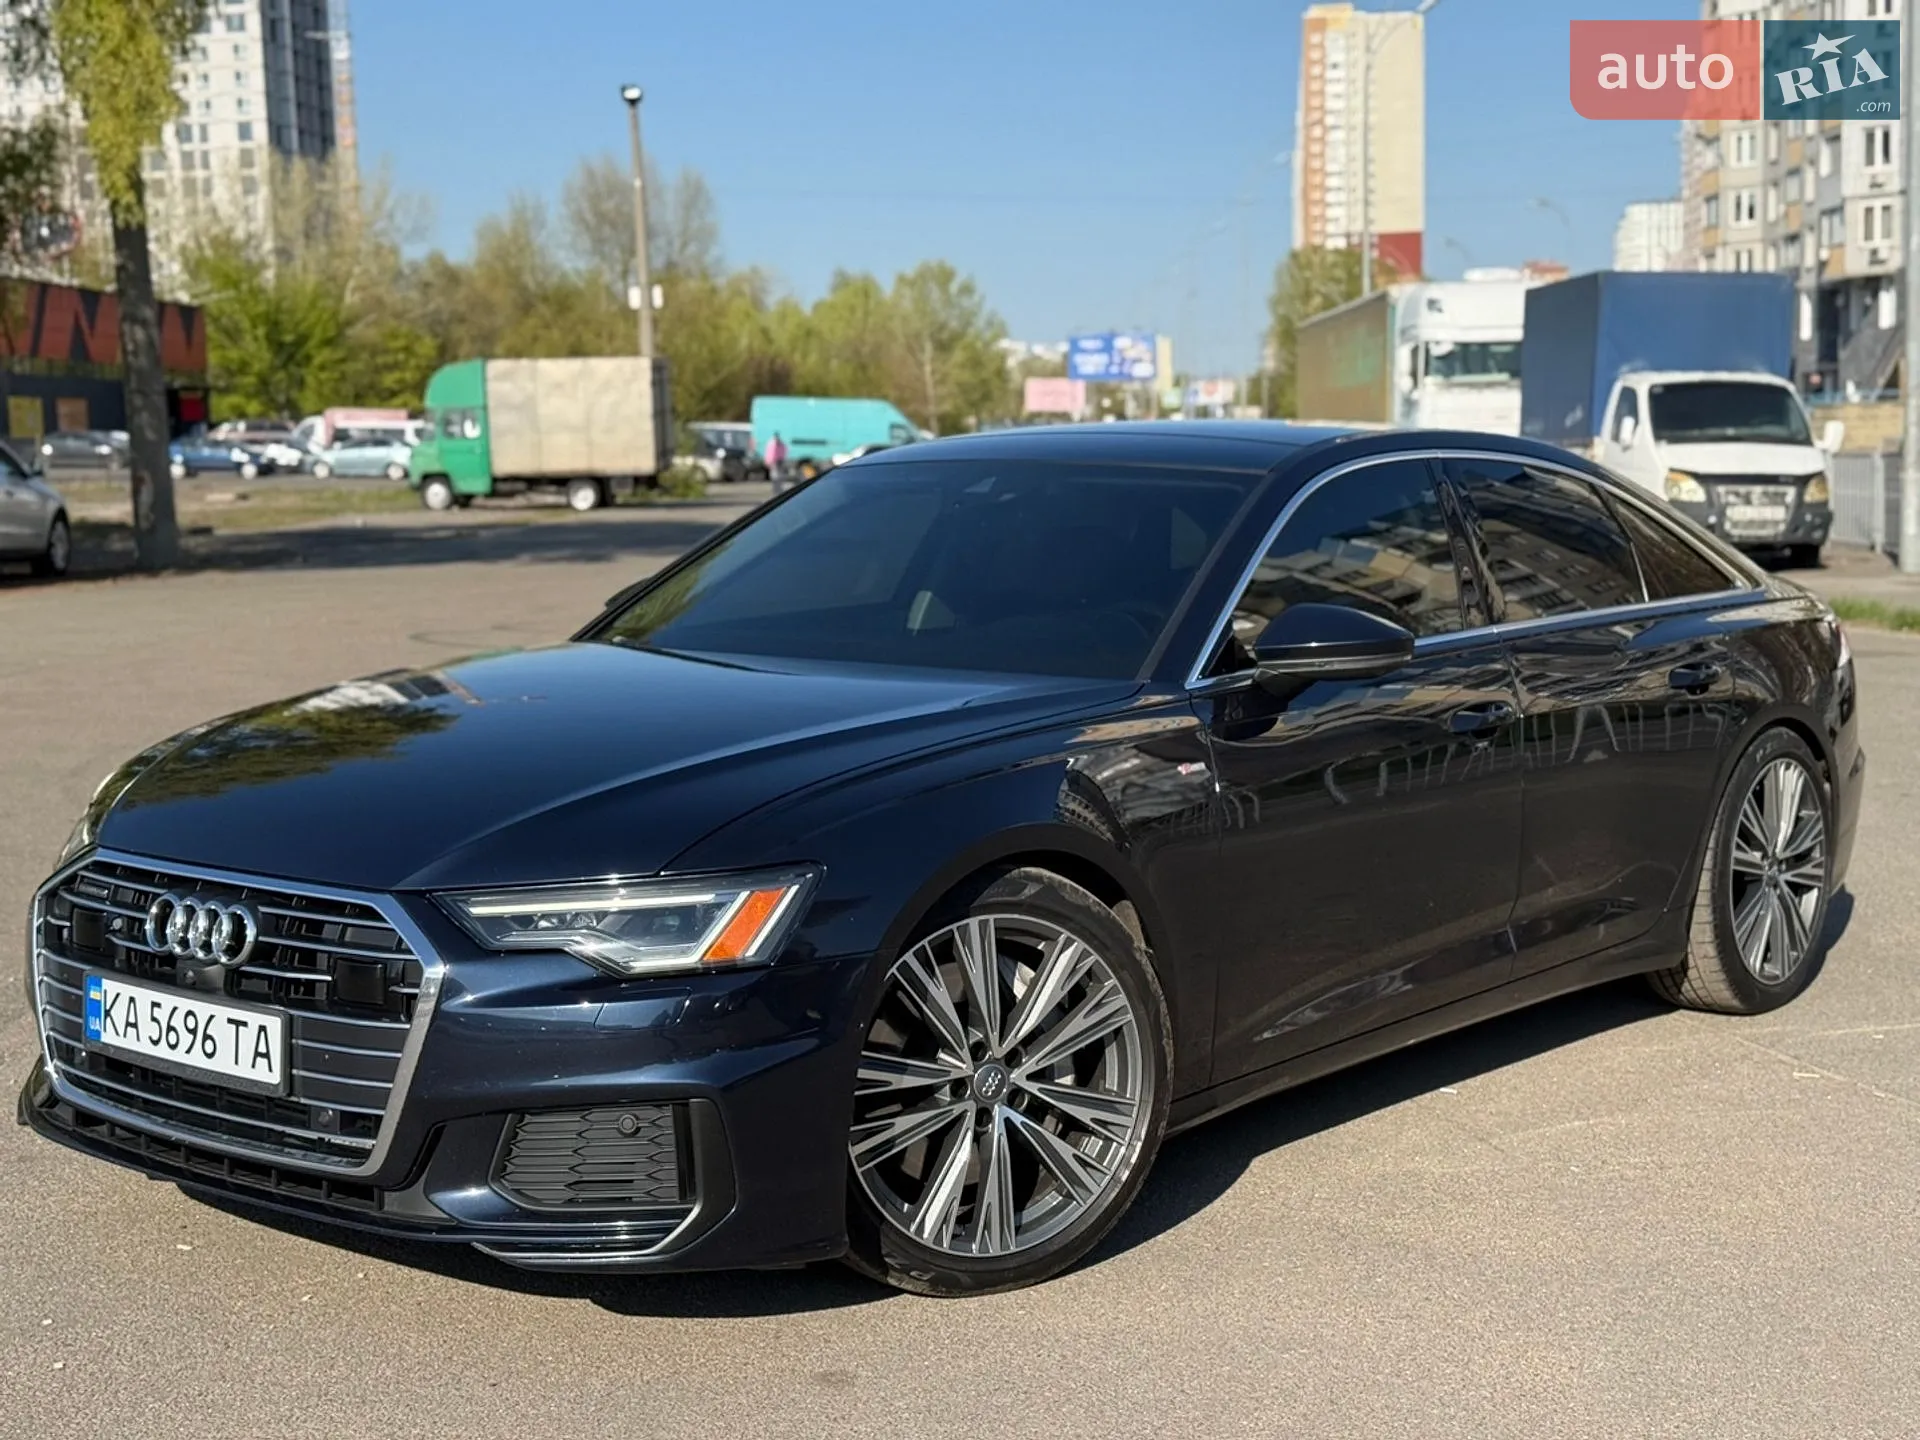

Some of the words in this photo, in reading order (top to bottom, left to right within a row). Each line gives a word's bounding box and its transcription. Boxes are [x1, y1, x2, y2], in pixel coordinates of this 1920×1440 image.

[88, 1015, 102, 1032] UA
[103, 988, 141, 1043] KA
[148, 1000, 218, 1060] 5696
[226, 1017, 274, 1074] TA
